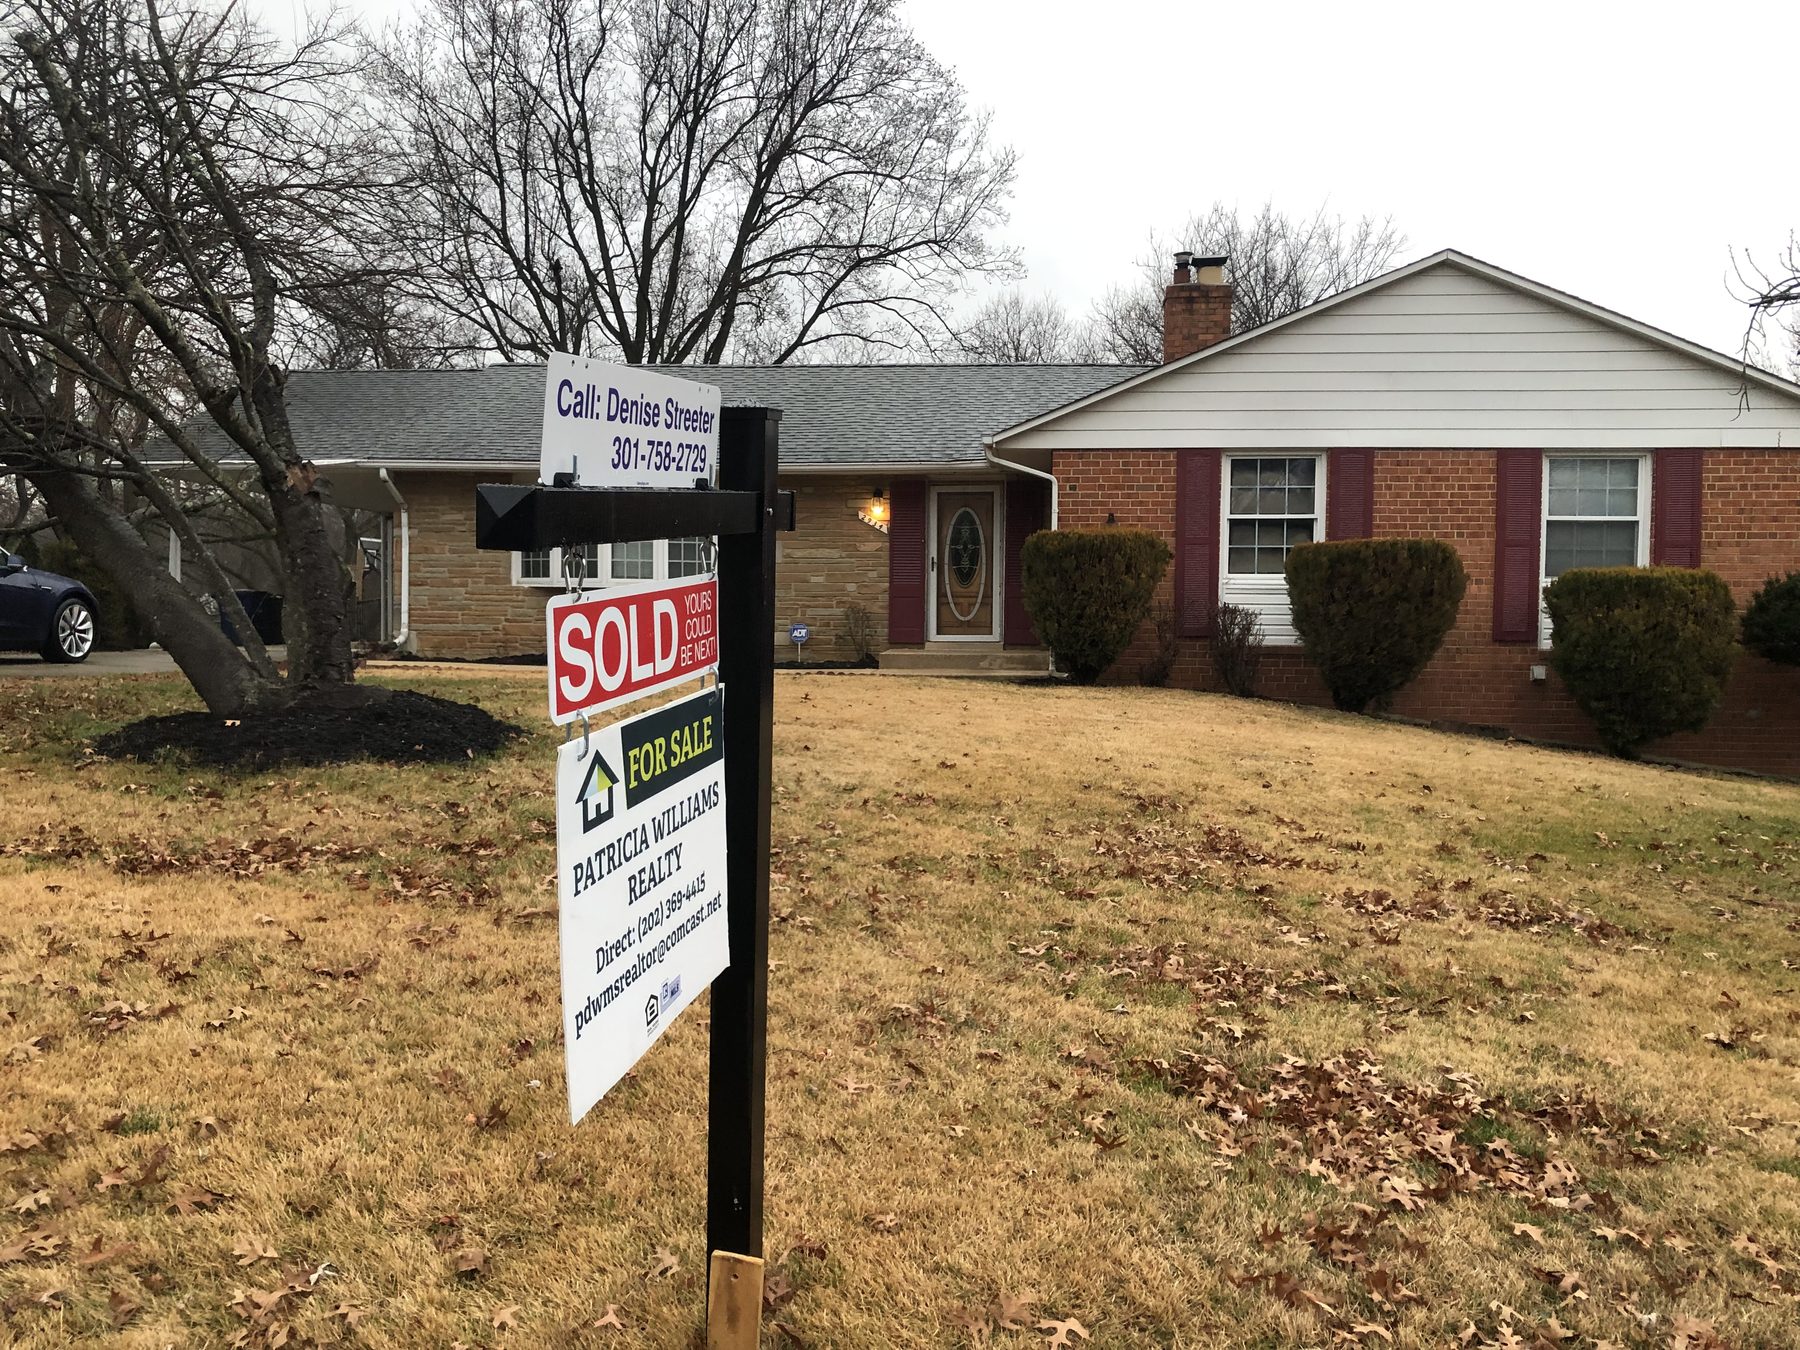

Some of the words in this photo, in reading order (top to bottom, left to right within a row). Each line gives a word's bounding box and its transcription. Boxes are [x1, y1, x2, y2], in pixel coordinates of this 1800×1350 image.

[557, 379, 600, 420] Call:
[606, 387, 661, 428] Denise
[664, 397, 715, 434] Streeter
[611, 436, 707, 473] 301-758-2729
[684, 590, 712, 615] YOURS
[685, 614, 712, 640] COULD
[559, 598, 679, 702] SOLD
[680, 644, 693, 667] BE
[694, 636, 716, 663] NEXT!
[792, 629, 807, 637] ADT
[628, 737, 668, 789] FOR
[670, 715, 713, 768] SALE
[573, 823, 650, 897] PATRICIA
[651, 781, 719, 844] WILLIAMS
[628, 842, 683, 905] REALTY
[595, 928, 636, 974] Direct:
[637, 903, 664, 943] (202)
[665, 870, 706, 919] 369-4415
[575, 892, 722, 1040] pdwmsrealtor@comcast.net
